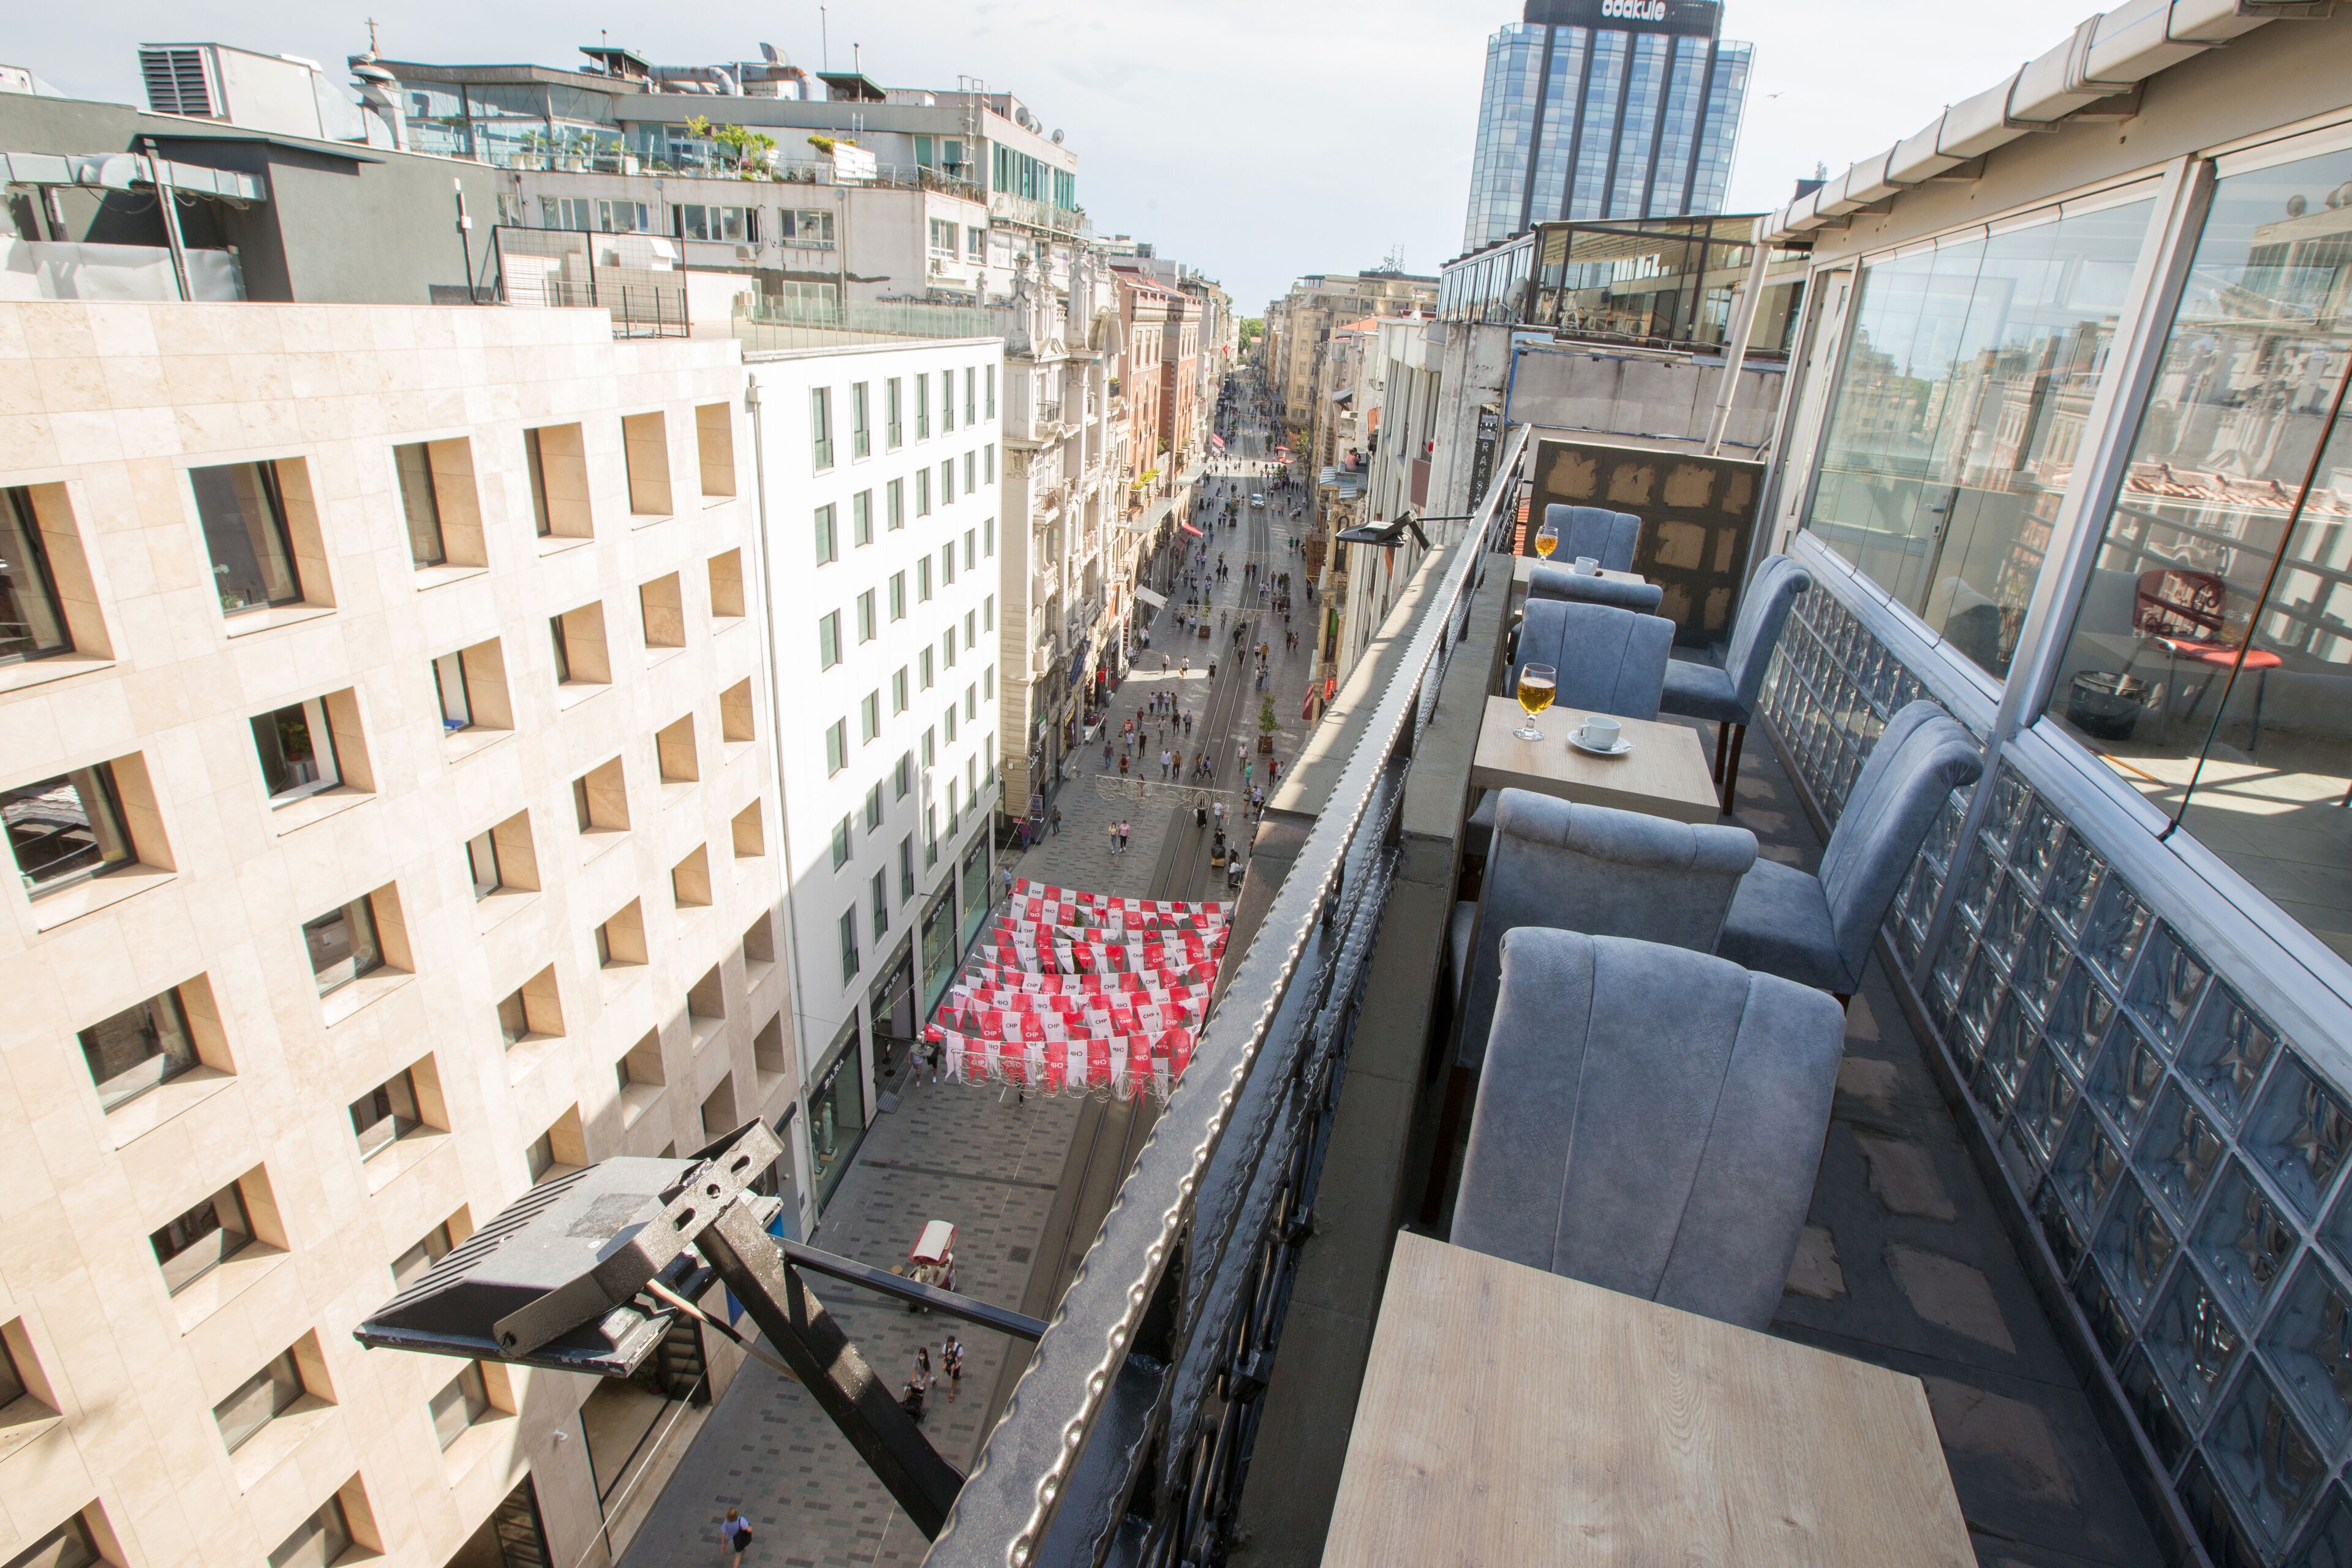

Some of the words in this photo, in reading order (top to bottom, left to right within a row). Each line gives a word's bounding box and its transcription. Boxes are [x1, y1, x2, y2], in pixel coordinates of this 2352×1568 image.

[932, 902, 945, 922] ZARA
[884, 971, 900, 997] ZARA
[824, 1058, 845, 1090] ZARA
